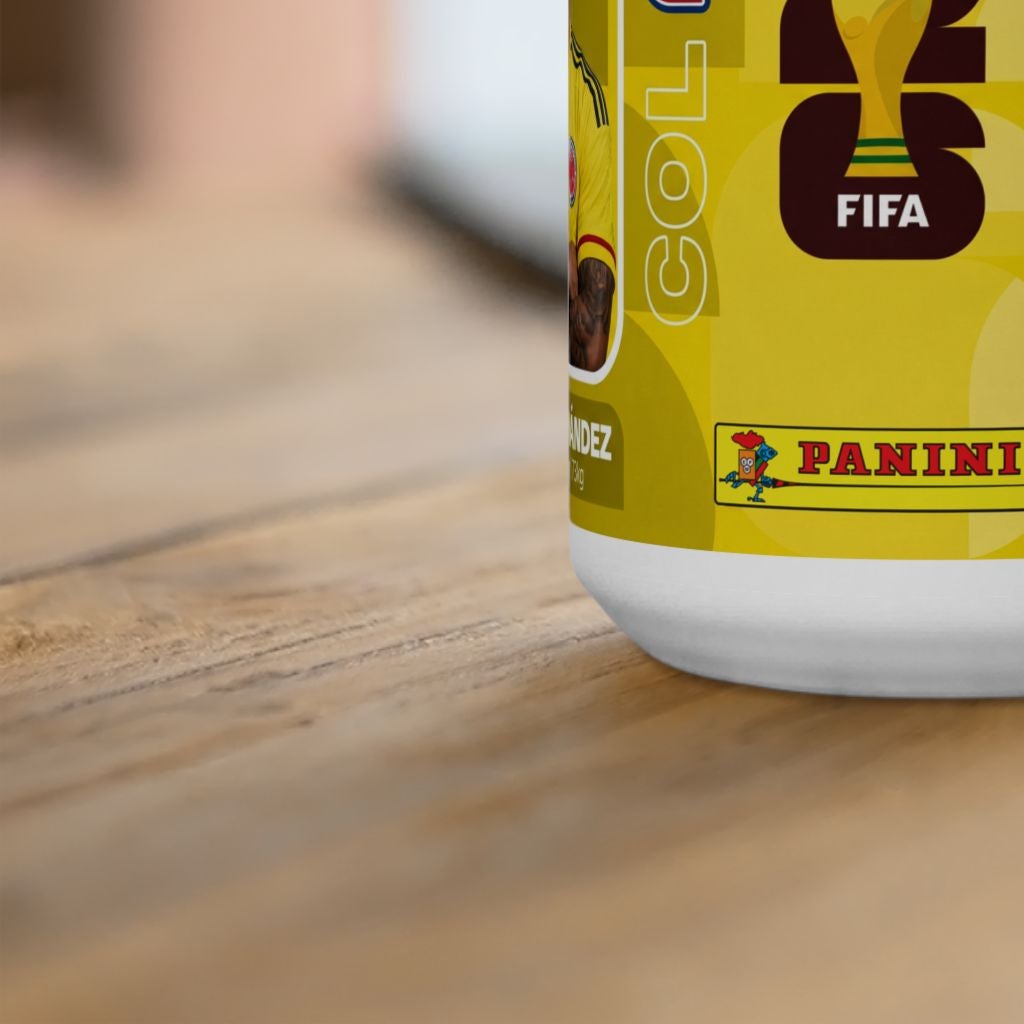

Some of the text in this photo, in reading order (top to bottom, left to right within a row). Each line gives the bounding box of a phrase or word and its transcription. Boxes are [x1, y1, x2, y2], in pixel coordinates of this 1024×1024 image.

[645, 39, 707, 326] COL
[837, 194, 930, 228] FIFA
[798, 440, 1021, 476] PANINI
